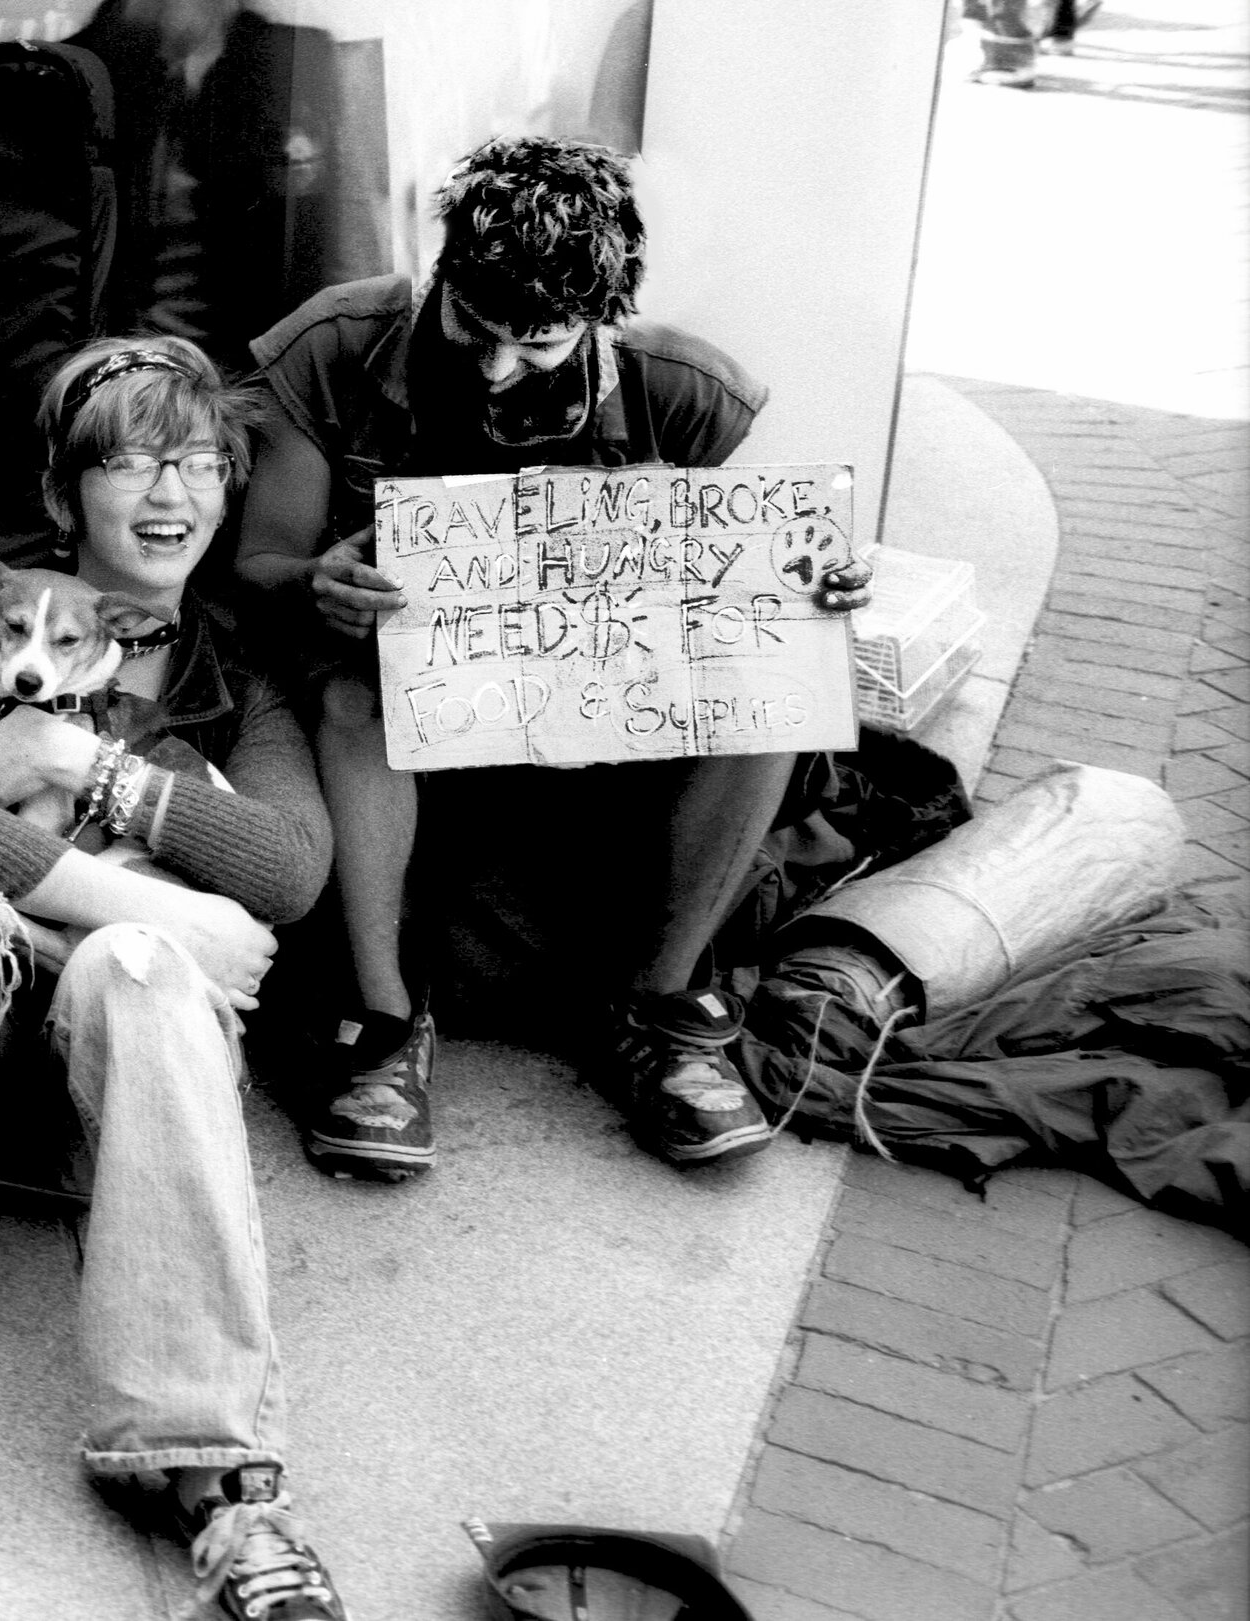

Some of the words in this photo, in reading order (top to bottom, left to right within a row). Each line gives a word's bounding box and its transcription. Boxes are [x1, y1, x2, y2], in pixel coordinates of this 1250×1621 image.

[670, 475, 832, 531] BROKE,
[428, 552, 519, 592] AND
[537, 534, 746, 590] HUNGRY
[425, 601, 570, 667] NEED
[680, 593, 790, 655] FOR
[406, 672, 552, 746] FOOD
[579, 680, 612, 723] &
